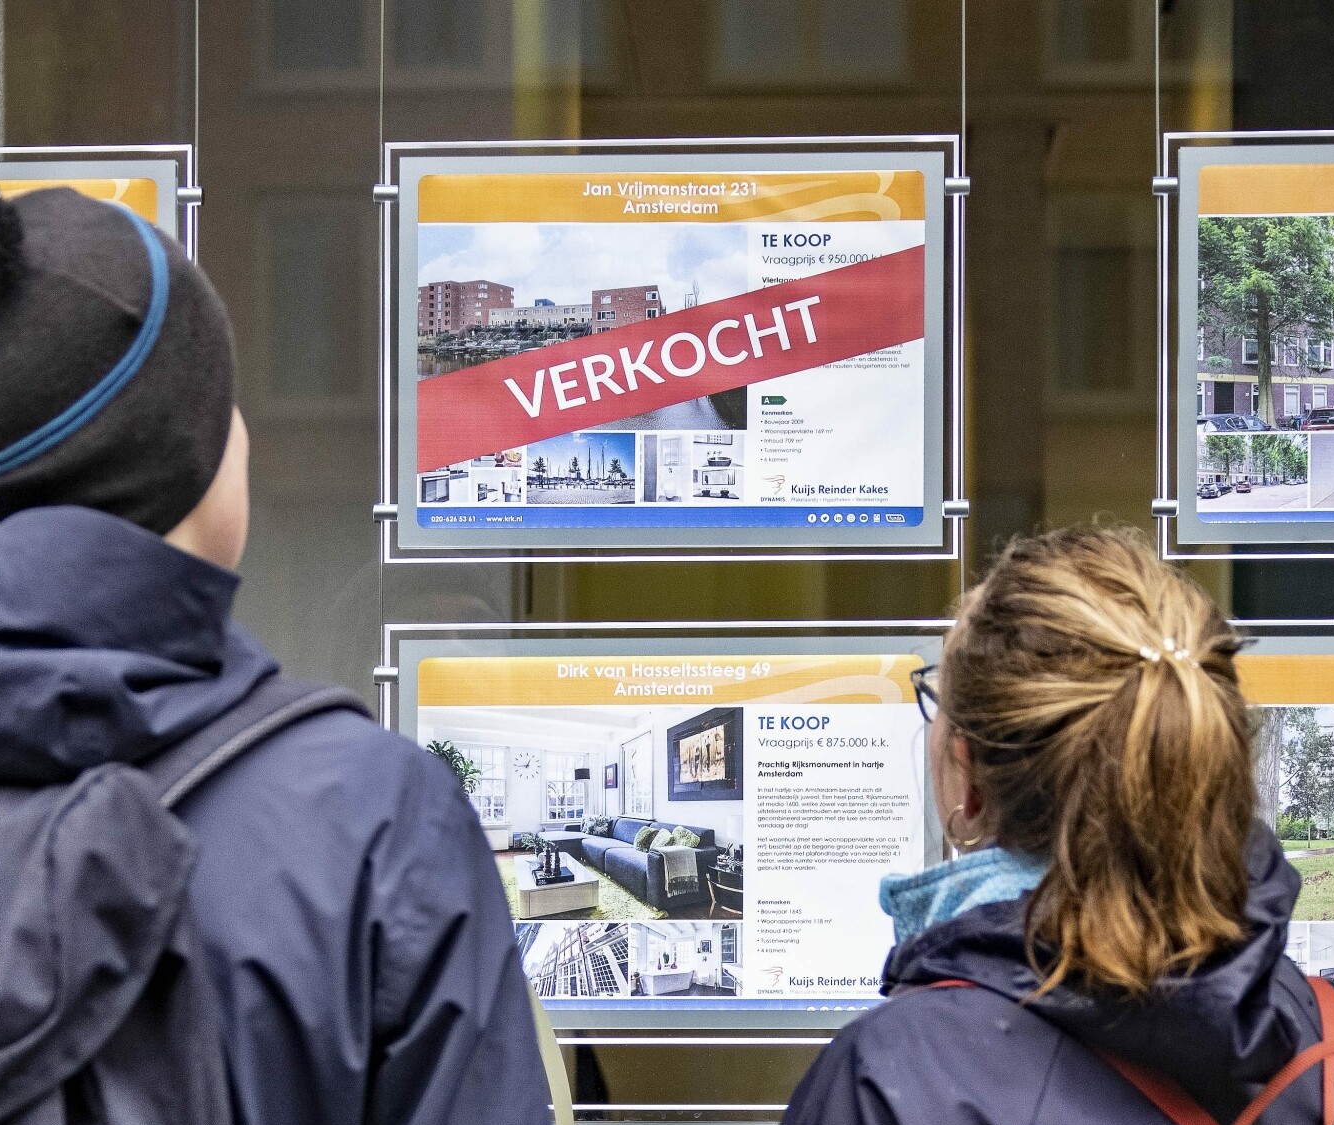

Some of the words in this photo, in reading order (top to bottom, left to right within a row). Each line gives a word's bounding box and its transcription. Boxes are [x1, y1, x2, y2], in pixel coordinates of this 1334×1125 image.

[583, 182, 612, 196] Jan
[617, 181, 726, 199] Vrijmanstraat
[730, 182, 759, 197] 231
[623, 198, 718, 214] Amsterdam
[762, 234, 777, 247] TE
[784, 234, 831, 247] KOOP
[762, 255, 815, 266] Vraagprijs
[819, 254, 825, 263] €
[828, 254, 869, 264] 950.000
[505, 296, 821, 419] VERKOCHT
[792, 485, 815, 496] Kuijs
[819, 485, 856, 494] Reinder
[860, 485, 888, 494] Kakes
[558, 664, 588, 677] Dirk
[594, 667, 625, 678] van
[632, 662, 747, 680] Hasseltssteeg
[751, 662, 772, 676] 49
[615, 681, 713, 695] Amsterdam
[758, 717, 774, 729] TE
[781, 716, 829, 730] KOOP
[758, 738, 813, 749] Vraagprijs
[817, 738, 823, 747] €
[826, 738, 868, 747] 875.000
[872, 738, 888, 747] k.k.
[758, 761, 789, 769] Prachtig
[792, 761, 851, 769] Rijksmonument
[862, 761, 884, 769] hartje
[790, 977, 814, 988] Kuijs
[818, 977, 856, 986] Reinder
[860, 977, 884, 986] Kake
